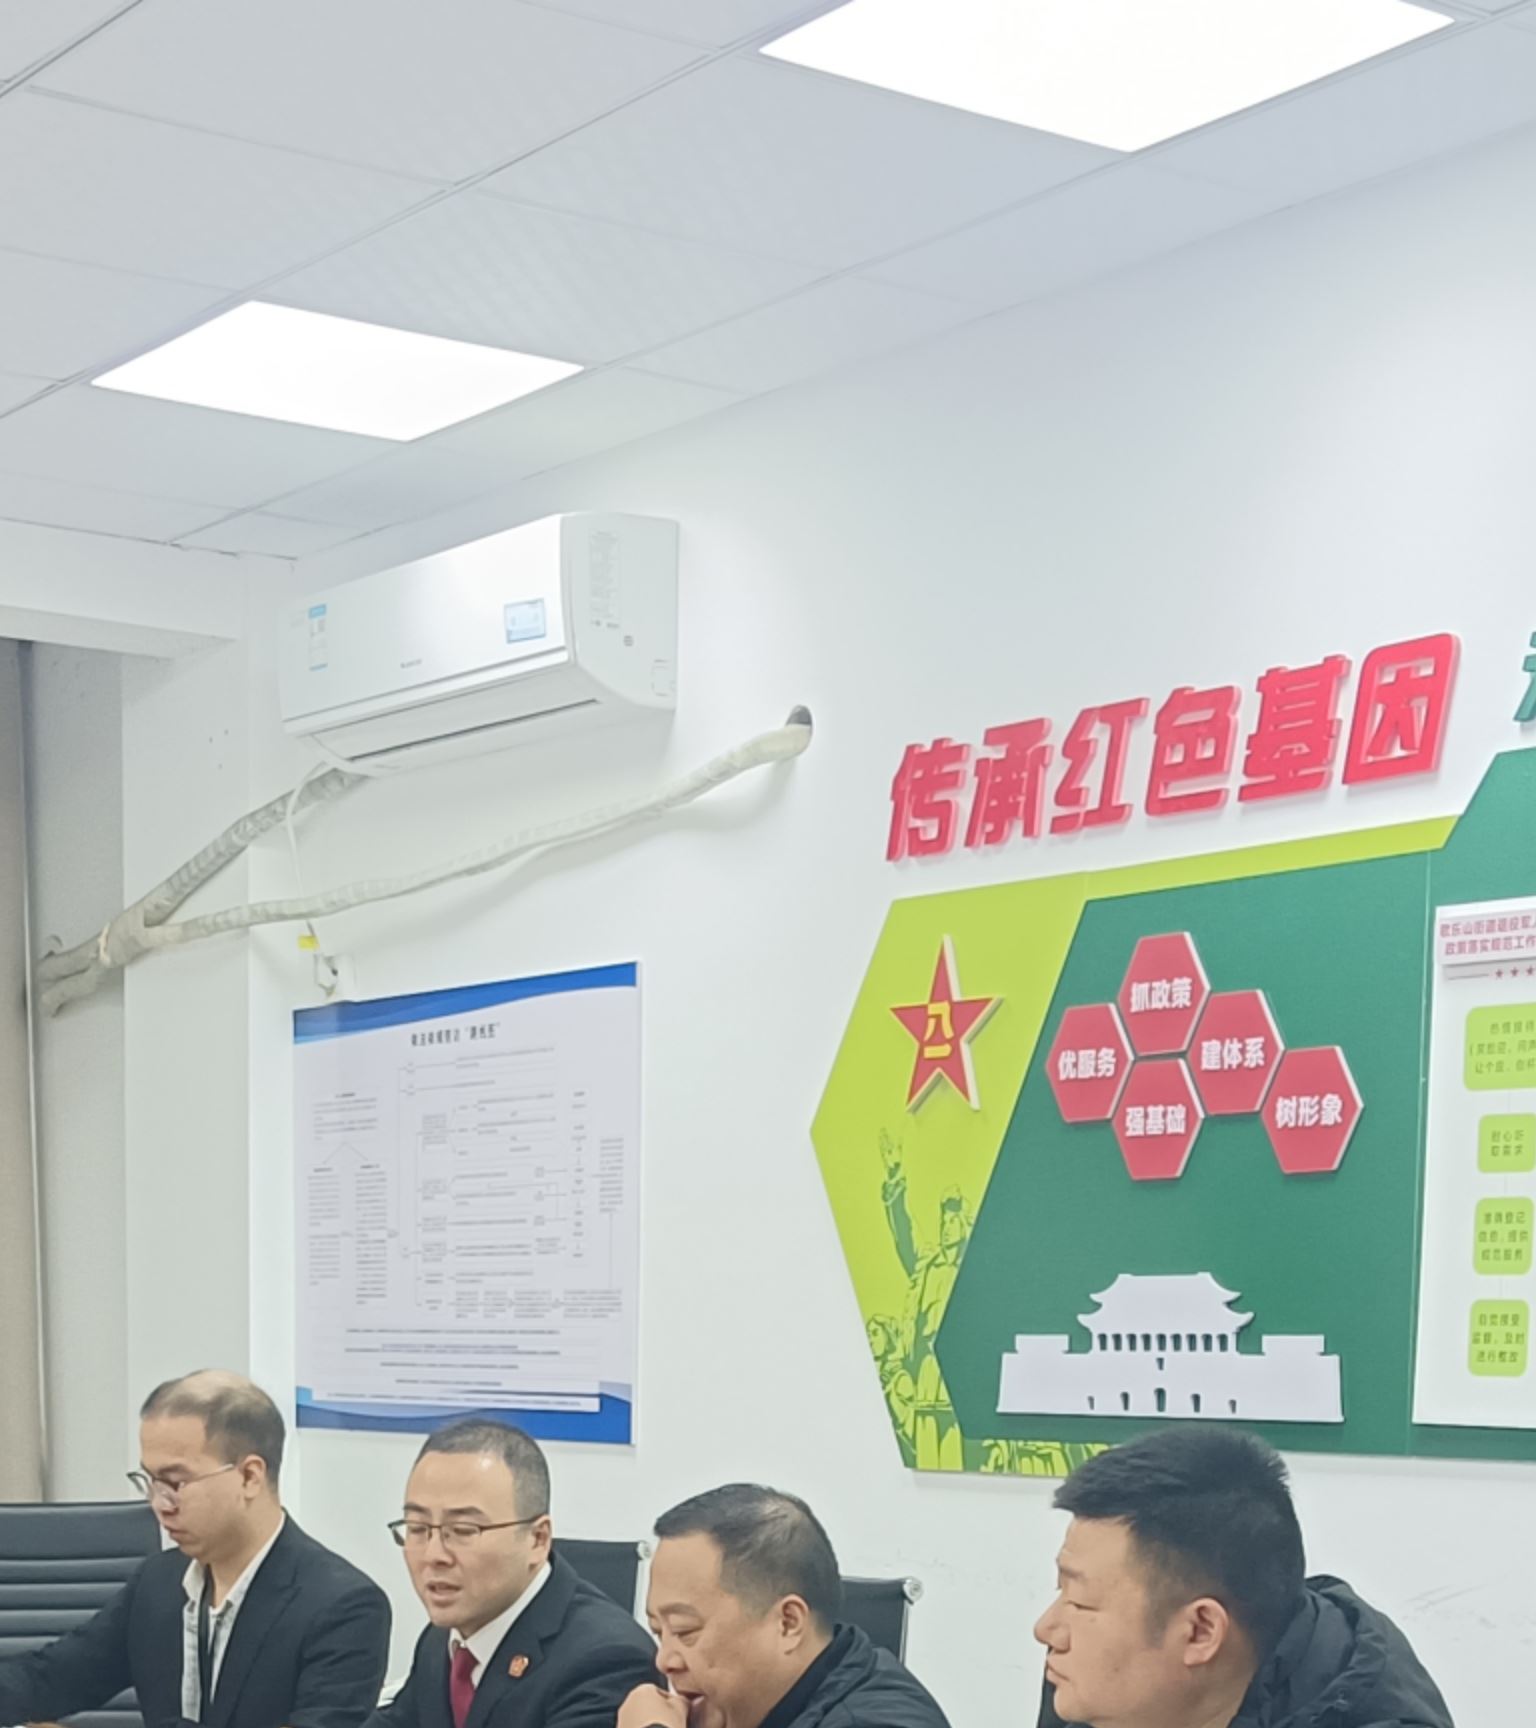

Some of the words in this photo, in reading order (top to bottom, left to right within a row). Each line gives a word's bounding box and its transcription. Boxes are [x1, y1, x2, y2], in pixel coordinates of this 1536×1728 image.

[885, 633, 1460, 862] 传承红色基因
[1130, 978, 1192, 1013] 抓政策
[1058, 1048, 1117, 1081] 优服务
[1200, 1037, 1265, 1072] 建体系
[1125, 1105, 1186, 1137] 强基础
[1275, 1094, 1342, 1130] 树形象
